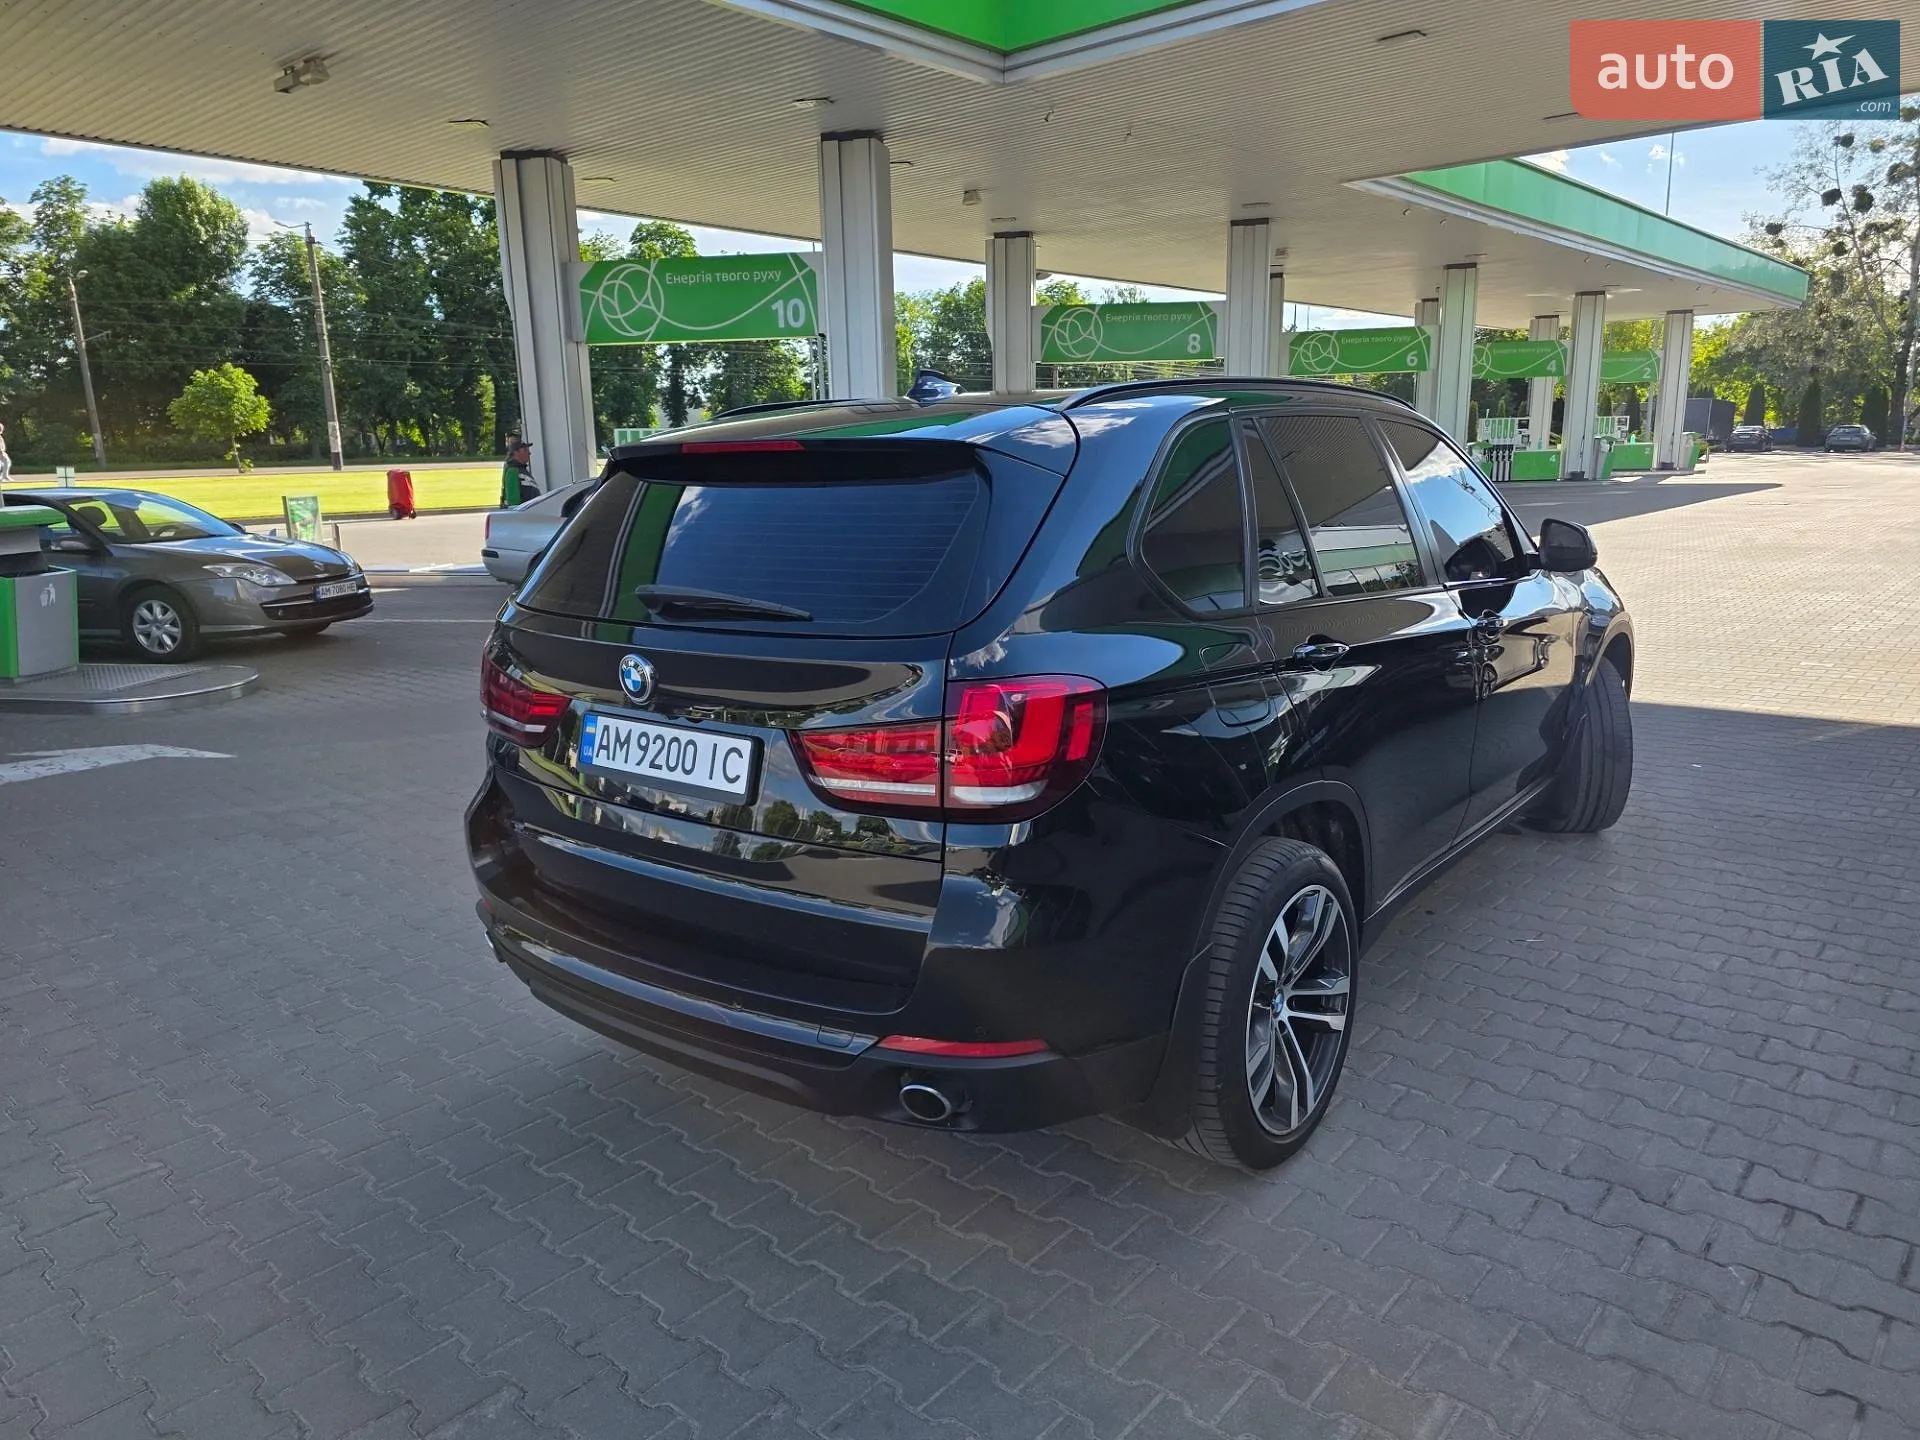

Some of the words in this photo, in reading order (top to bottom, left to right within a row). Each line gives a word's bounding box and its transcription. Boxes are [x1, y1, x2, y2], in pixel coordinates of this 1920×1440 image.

[665, 272, 712, 286] Енергія
[715, 272, 750, 283] твого
[753, 269, 782, 282] руху
[771, 298, 807, 329] 10
[1187, 333, 1201, 354] 8
[1406, 351, 1418, 367] 6
[1546, 359, 1557, 373] 4
[1642, 367, 1651, 379] 2
[583, 745, 593, 757] UA
[595, 724, 632, 764] AM
[635, 731, 698, 776] 9200
[708, 742, 744, 784] IC
